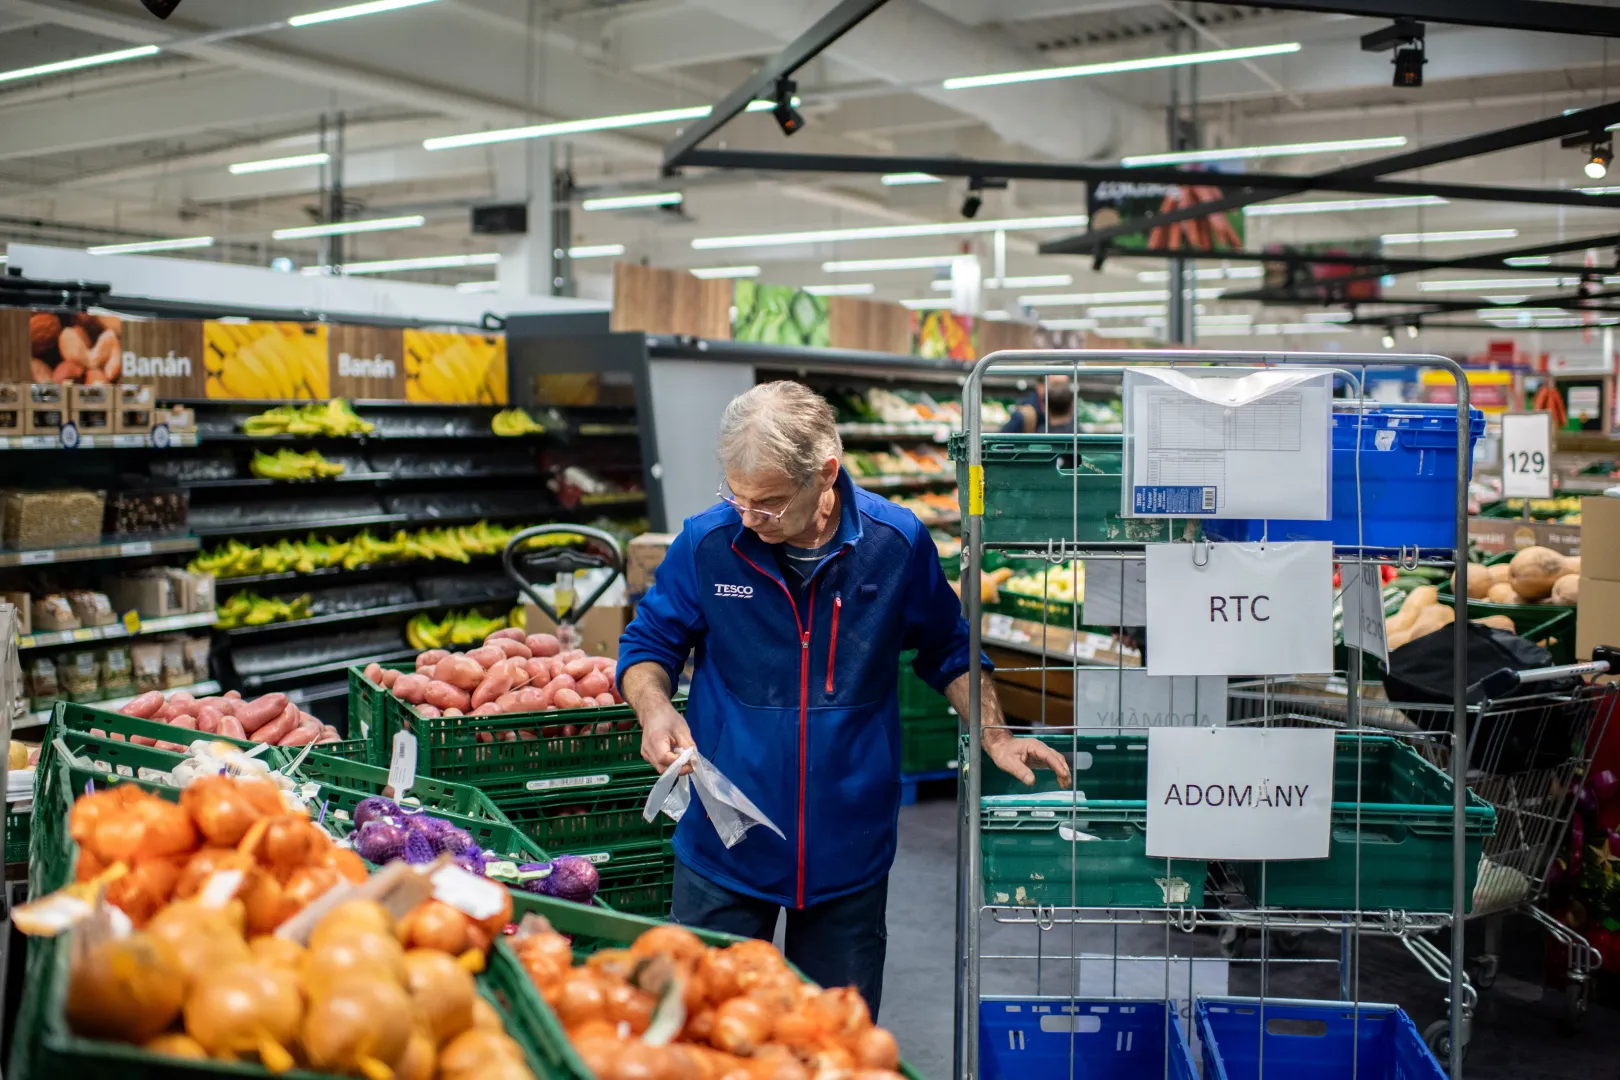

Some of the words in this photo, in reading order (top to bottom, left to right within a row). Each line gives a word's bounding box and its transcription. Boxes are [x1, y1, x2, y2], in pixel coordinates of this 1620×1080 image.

[122, 350, 192, 377] Banán
[338, 352, 396, 378] Banán
[1508, 450, 1545, 473] 129
[714, 583, 754, 595] TESCO
[1210, 595, 1270, 623] RTC
